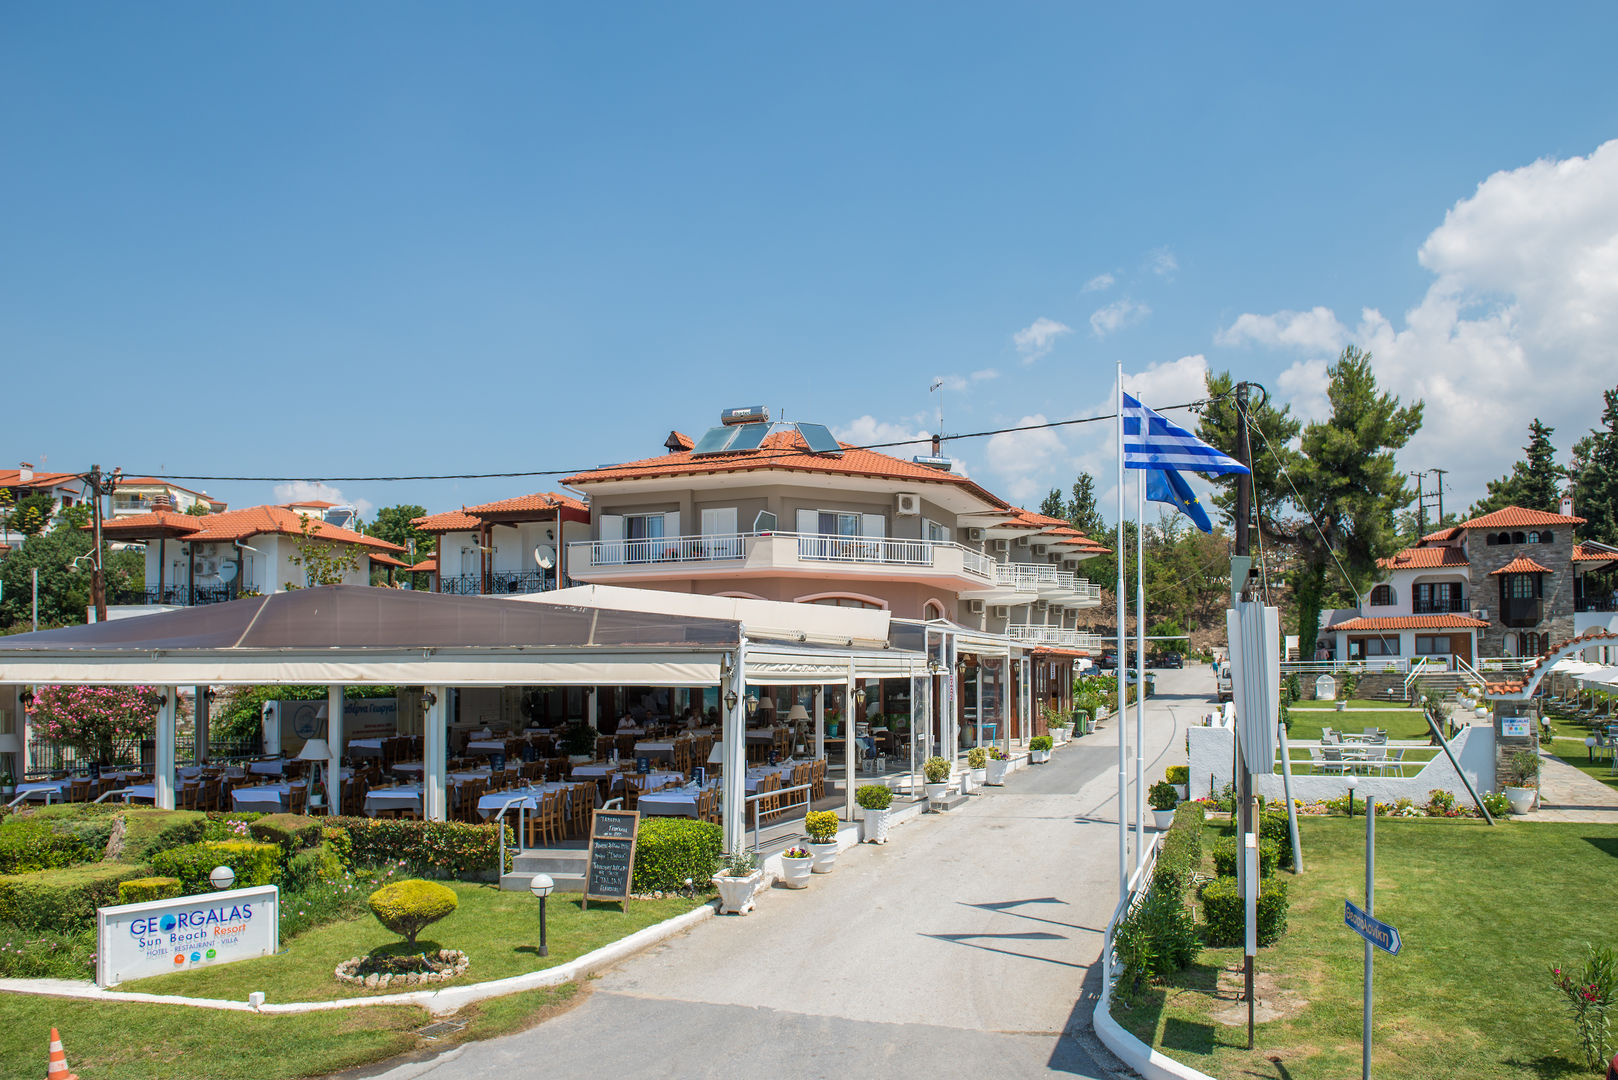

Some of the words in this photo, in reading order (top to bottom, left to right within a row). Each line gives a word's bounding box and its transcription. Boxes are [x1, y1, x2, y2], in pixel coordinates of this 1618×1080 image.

[344, 702, 368, 717] αβέρνα
[130, 904, 253, 935] GEORGALAS
[1346, 906, 1389, 948] Θεσσαλονίκη
[139, 937, 162, 948] Sun
[170, 929, 207, 943] Beach
[214, 923, 246, 936] Resort
[146, 948, 168, 957] HOTEL
[174, 940, 216, 953] RESTAURANT
[221, 937, 239, 945] VILLA
